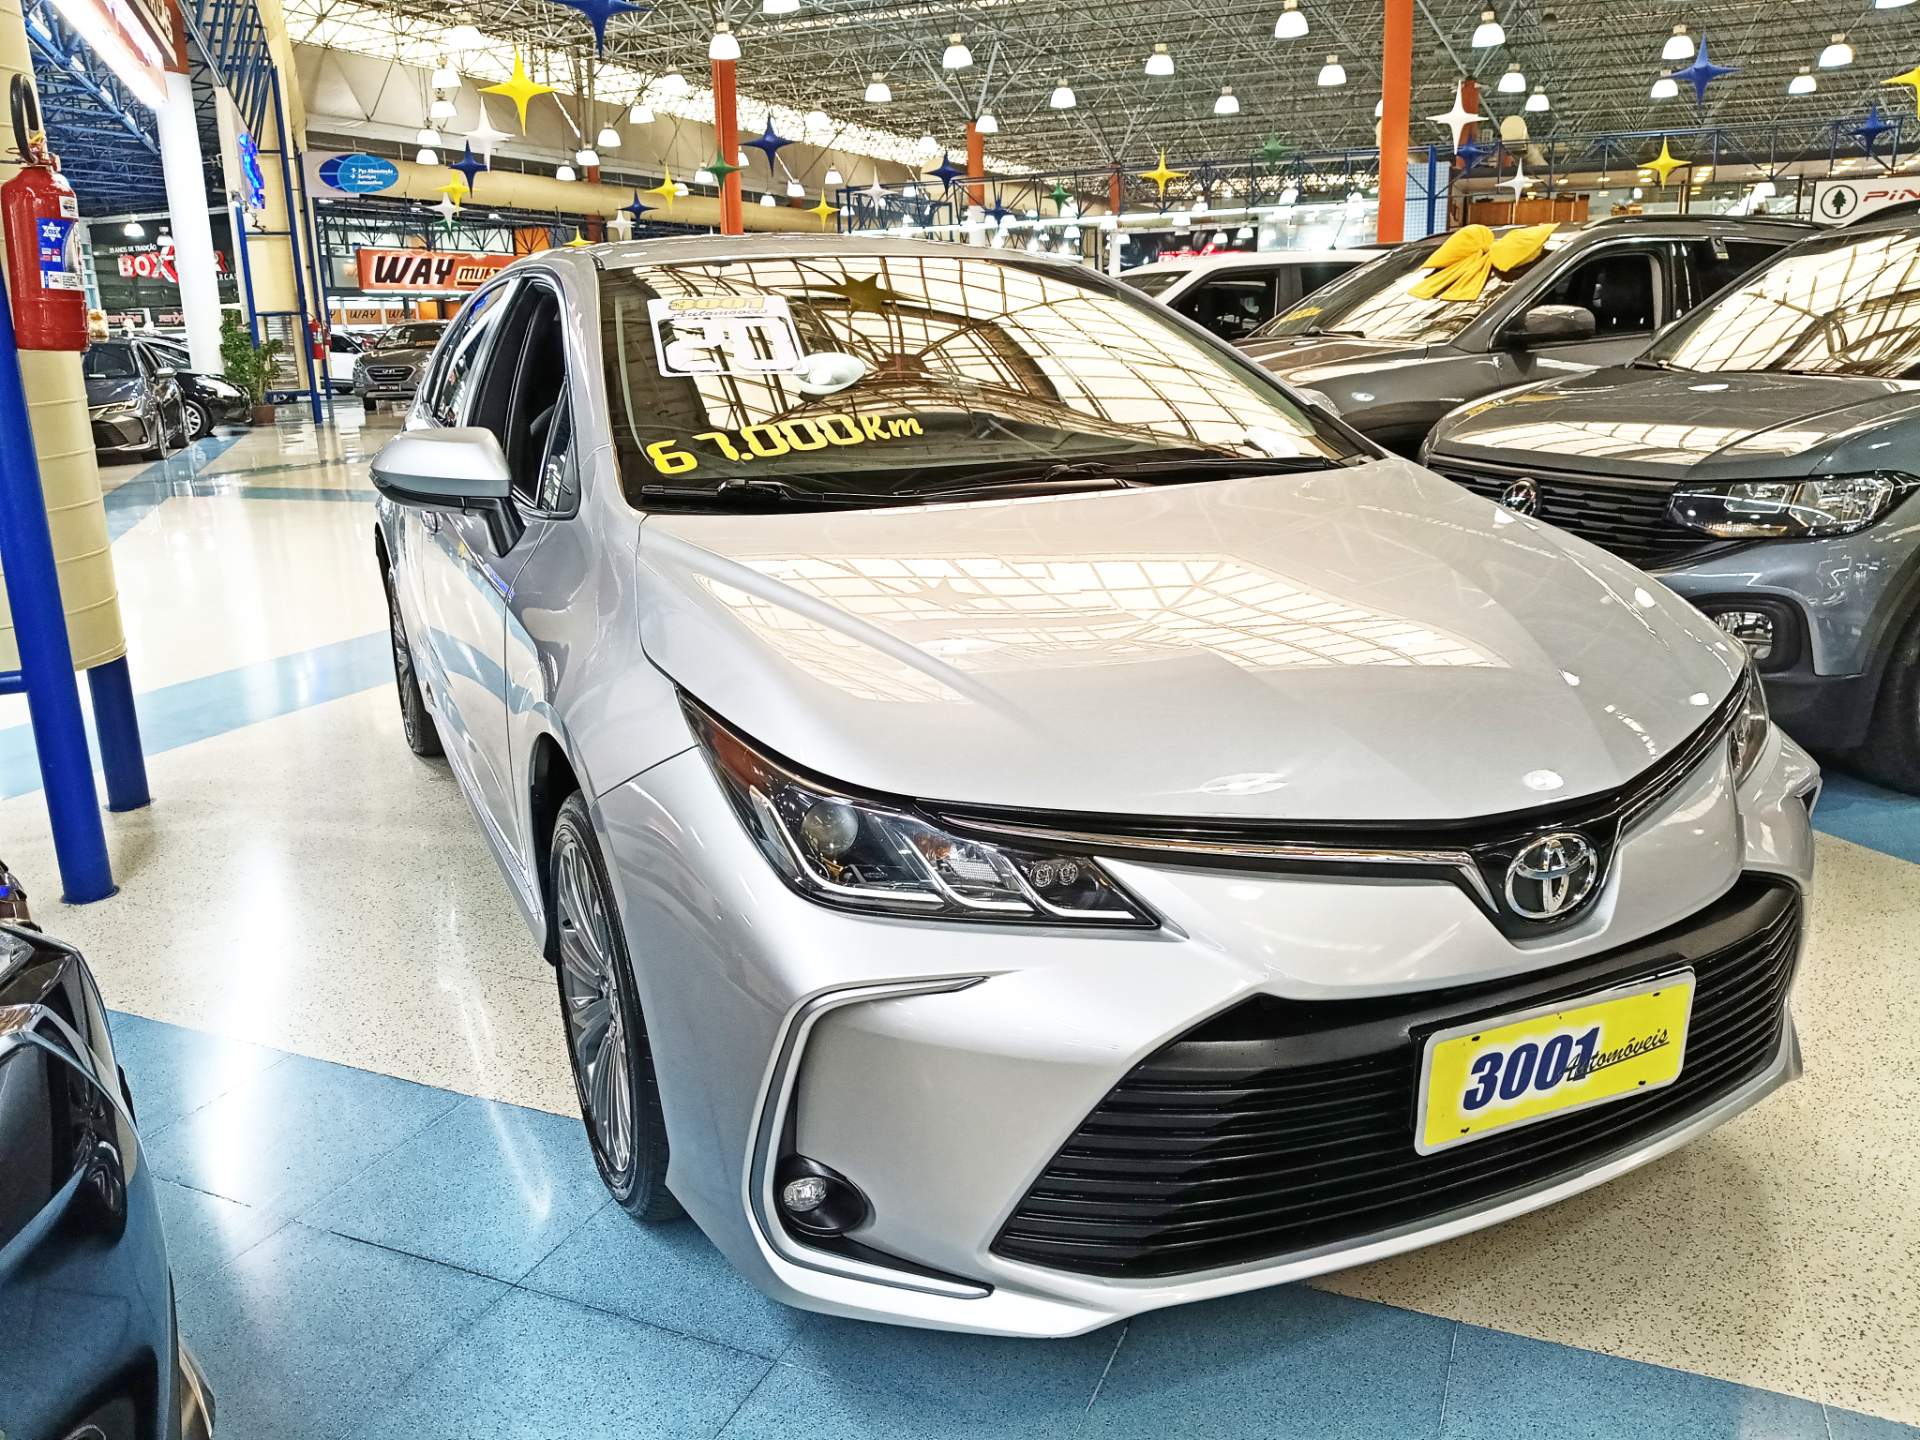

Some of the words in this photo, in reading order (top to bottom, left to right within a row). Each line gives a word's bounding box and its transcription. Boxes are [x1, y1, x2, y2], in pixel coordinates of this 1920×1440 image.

[374, 256, 455, 285] WAY
[350, 310, 377, 319] WAY
[1462, 1026, 1601, 1111] 3001
[1563, 1028, 1670, 1082] Automóveis
